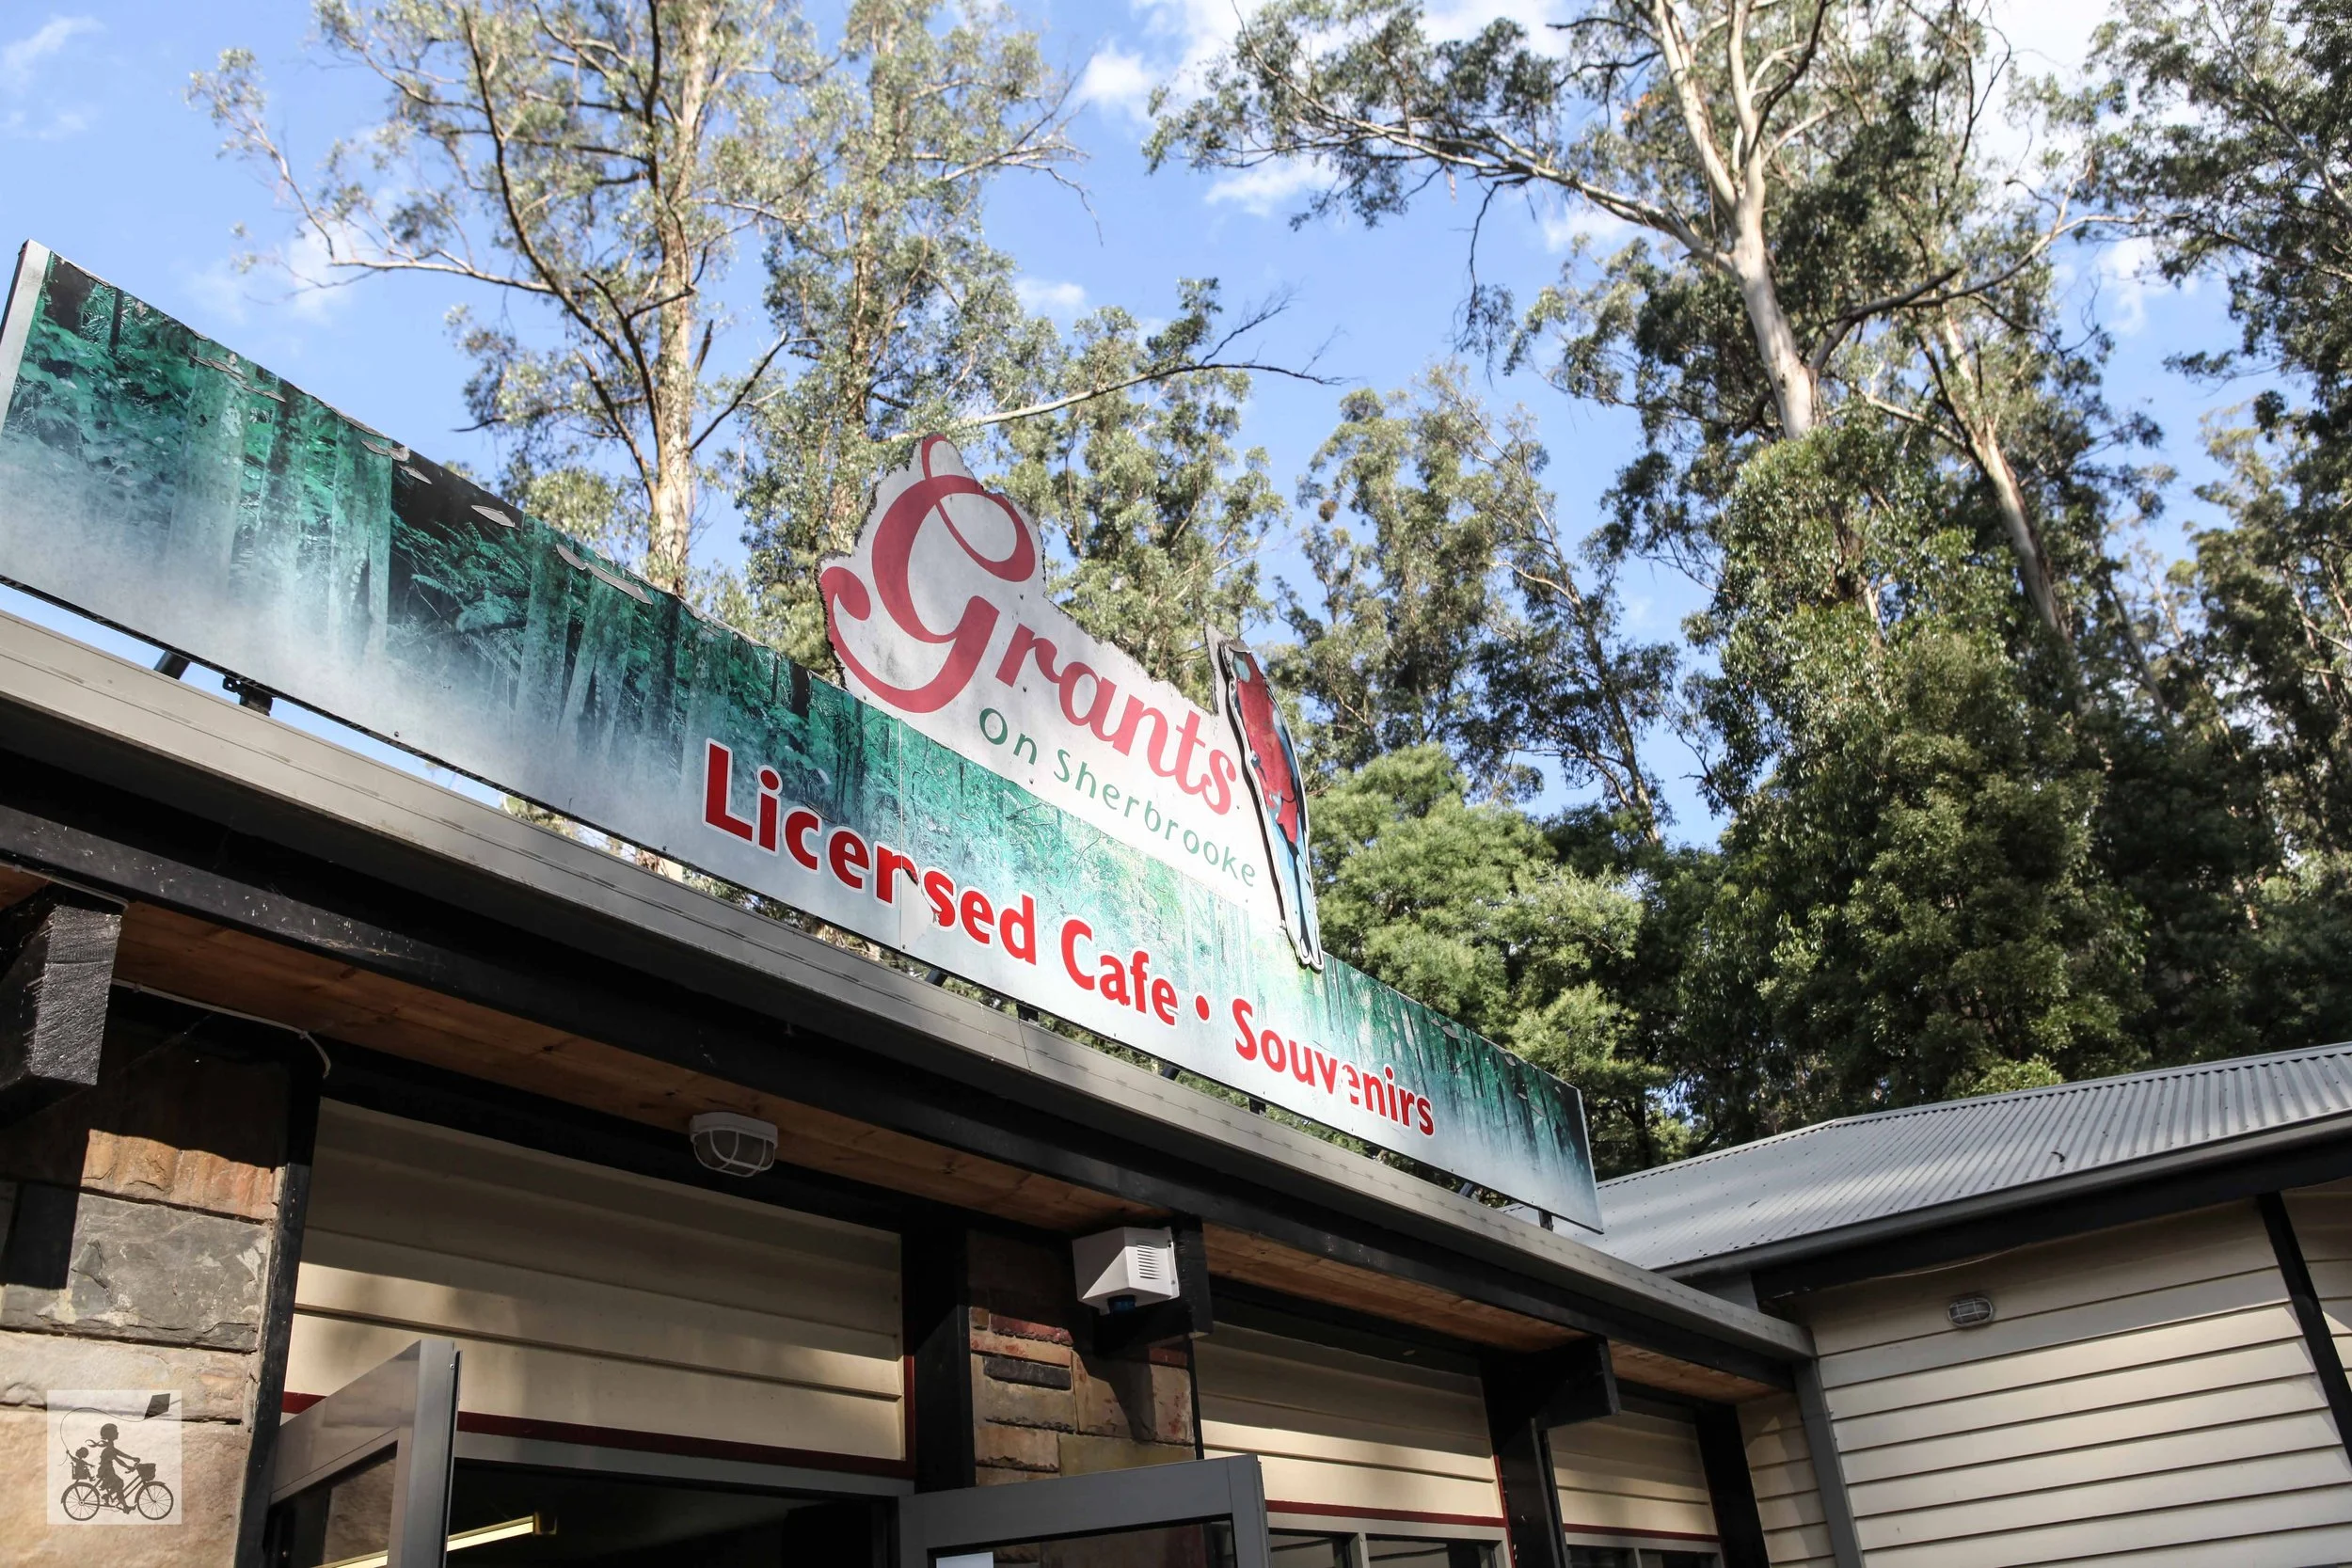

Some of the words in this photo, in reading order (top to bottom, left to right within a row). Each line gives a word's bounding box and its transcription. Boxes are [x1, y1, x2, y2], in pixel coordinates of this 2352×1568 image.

[819, 434, 1237, 816] Grants
[1053, 748, 1256, 887] Sherbrooke
[1060, 919, 1179, 1025] Cafe
